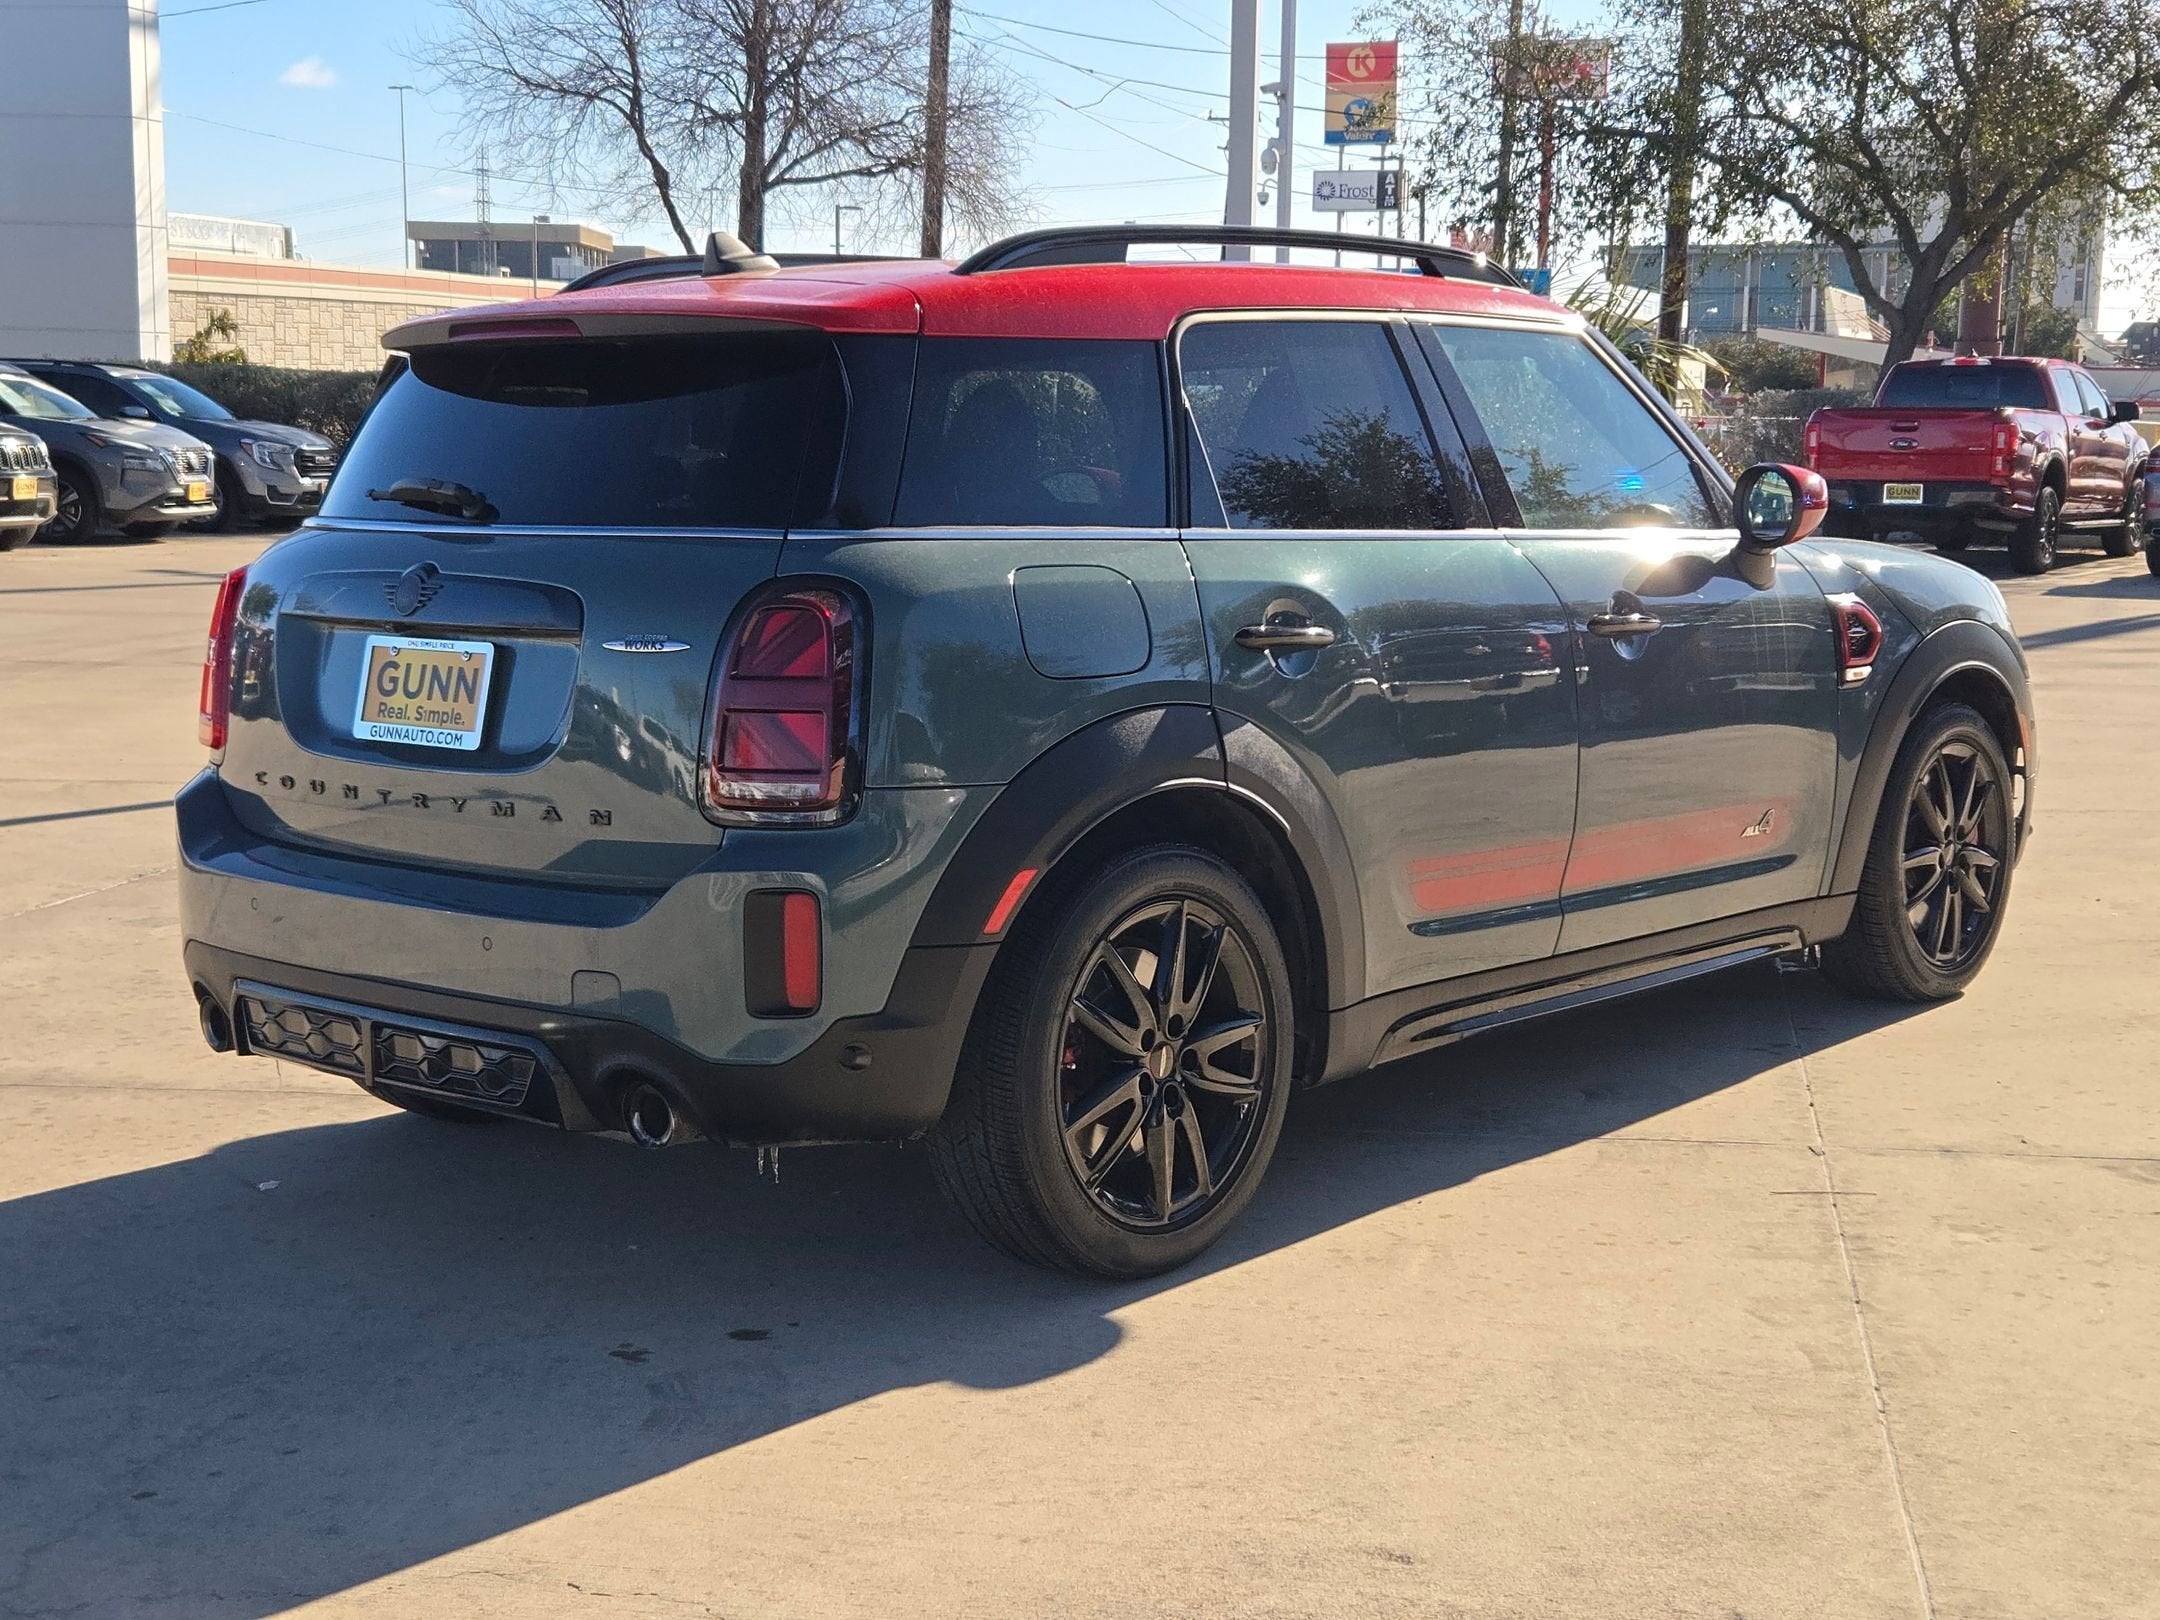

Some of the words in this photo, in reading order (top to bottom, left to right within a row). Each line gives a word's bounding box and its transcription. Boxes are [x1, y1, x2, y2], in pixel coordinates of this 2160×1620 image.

[1338, 183, 1375, 199] Frost
[1384, 172, 1396, 208] ATM
[1888, 487, 1920, 496] GUNN
[624, 640, 667, 651] WORKS
[376, 660, 480, 704] GUNN
[377, 701, 411, 721] Real.
[369, 724, 464, 747] GUNNAUTO.COM
[254, 770, 612, 828] COUNTRYMAN
